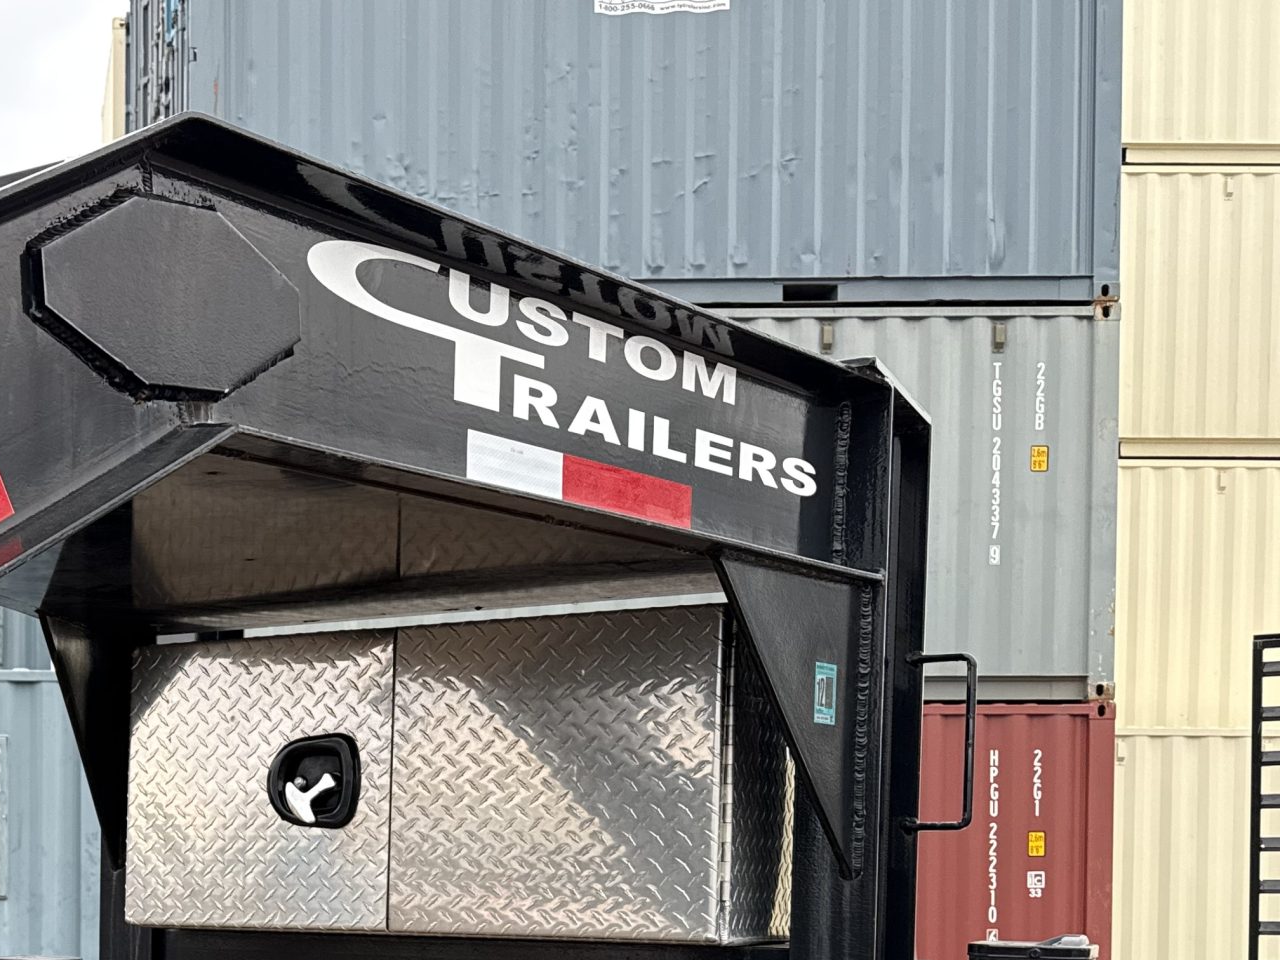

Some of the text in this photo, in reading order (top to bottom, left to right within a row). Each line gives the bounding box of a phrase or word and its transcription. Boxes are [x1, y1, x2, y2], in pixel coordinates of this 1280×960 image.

[307, 240, 736, 405] CUSTOM
[452, 332, 817, 497] TRAILERS
[990, 362, 1002, 564] TGSU 204337 9
[989, 749, 999, 817] HPGU
[1033, 749, 1043, 816] 22G1
[988, 823, 998, 923] 222310
[1028, 888, 1042, 897] 33
